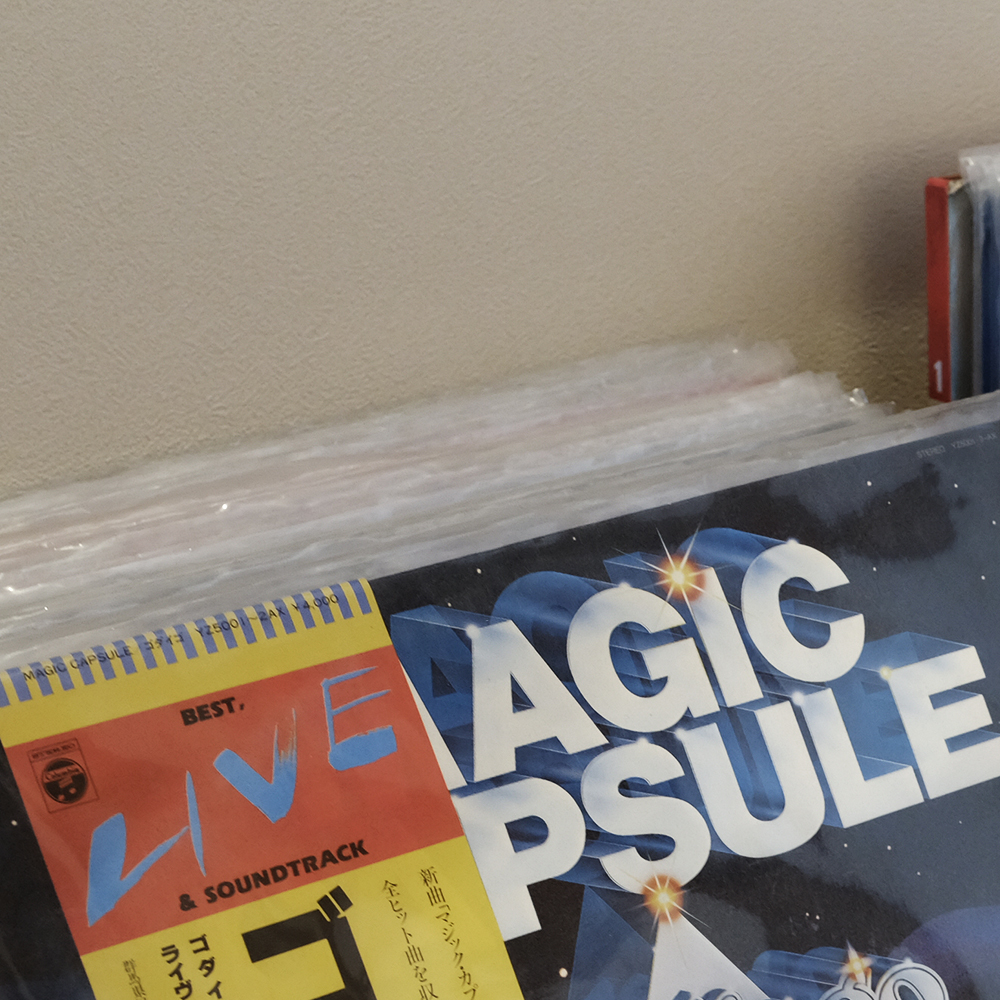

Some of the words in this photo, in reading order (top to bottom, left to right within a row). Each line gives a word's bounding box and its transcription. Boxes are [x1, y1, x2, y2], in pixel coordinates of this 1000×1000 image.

[933, 359, 944, 393] 1
[23, 662, 68, 682] MAGIC
[70, 645, 133, 669] CAPSULE
[398, 538, 867, 791] AGIC
[180, 696, 246, 727] BEST,
[86, 665, 398, 927] LIVE
[179, 892, 198, 912] &
[204, 837, 371, 905] SOUNDTRACK
